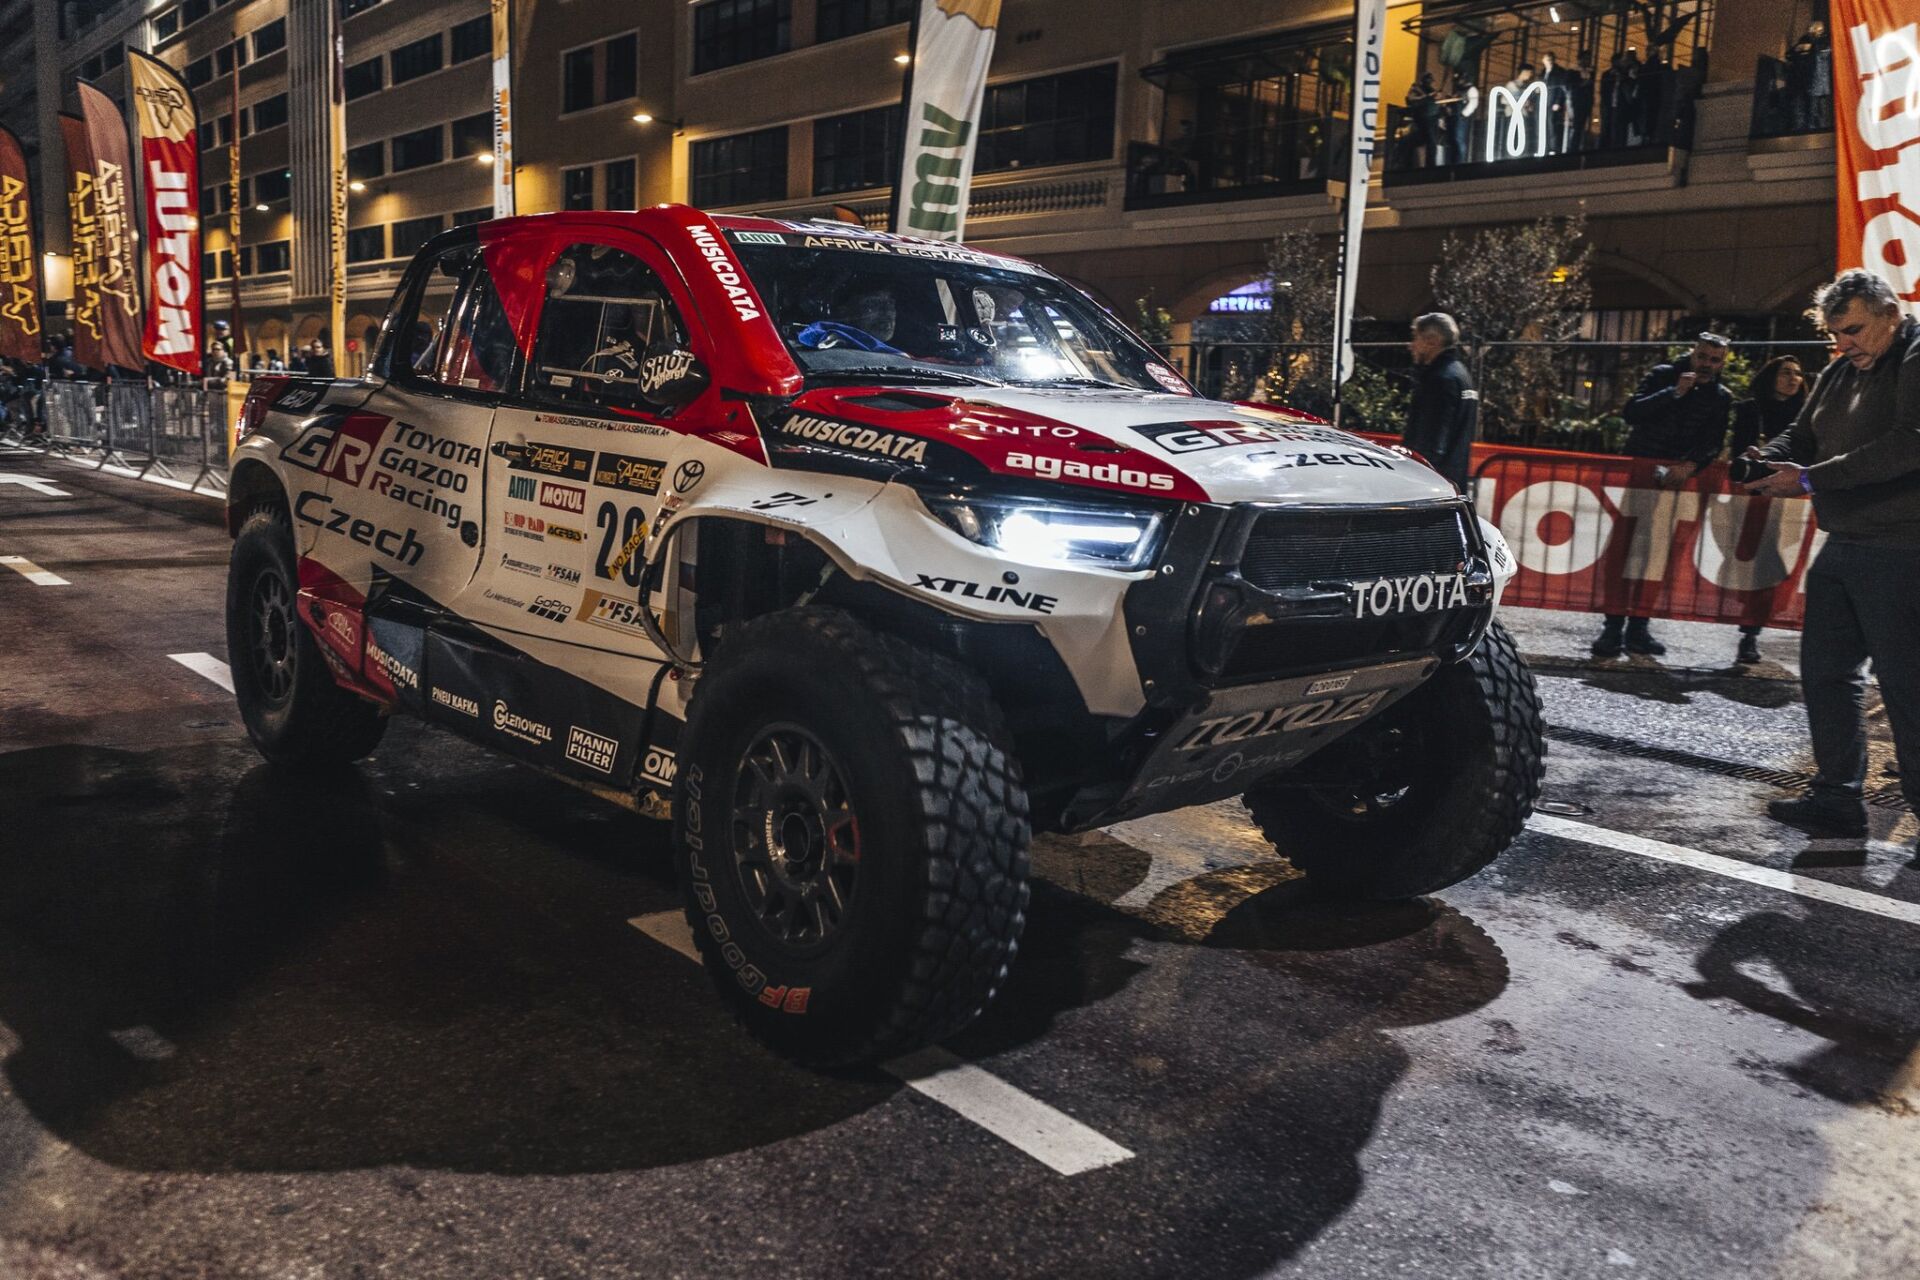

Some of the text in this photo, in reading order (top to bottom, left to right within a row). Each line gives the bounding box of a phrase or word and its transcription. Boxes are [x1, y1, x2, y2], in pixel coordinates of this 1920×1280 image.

[804, 236, 890, 253] AFRICA
[685, 225, 760, 323] MUSICDATA
[641, 354, 692, 393] SHOT
[391, 420, 483, 468] TOYOTA
[533, 447, 569, 466] AFRICA
[782, 415, 928, 463] MUSICDATA
[379, 448, 468, 494] GAZOO
[621, 461, 665, 482] AFRICA
[1005, 451, 1175, 491] agados
[1246, 451, 1396, 471] Czech
[369, 471, 462, 529] Racing
[541, 485, 583, 511] MOTUL
[294, 490, 426, 566] Czech
[1473, 477, 1830, 593] OTU
[611, 526, 647, 575] NO RACE
[554, 565, 582, 584] FSAM
[912, 572, 1060, 615] XTLINE
[534, 595, 572, 615] GoPro
[1351, 574, 1468, 619] TOYOTA
[365, 641, 419, 689] MUSICDATA
[432, 686, 480, 716] PNEU KAFKA
[569, 742, 612, 770] FILTER
[571, 729, 615, 756] MANN
[644, 752, 678, 783] OM
